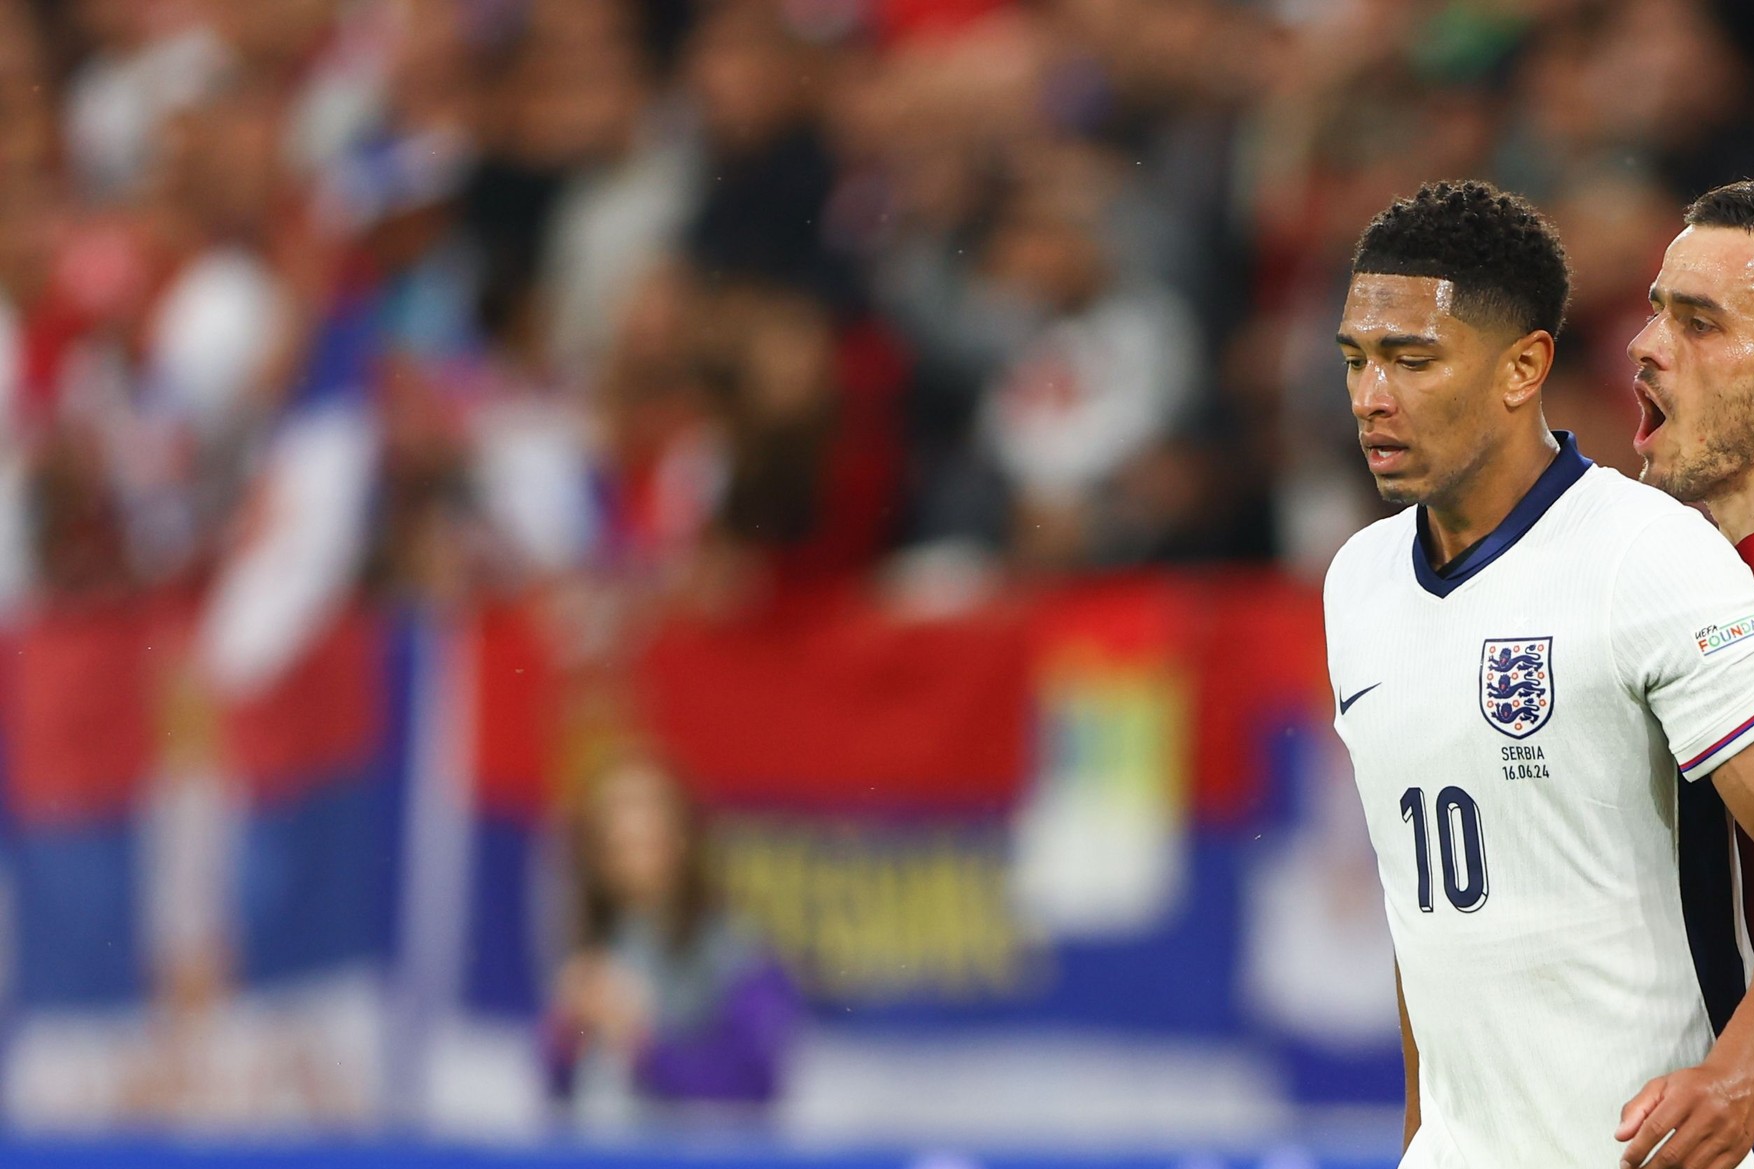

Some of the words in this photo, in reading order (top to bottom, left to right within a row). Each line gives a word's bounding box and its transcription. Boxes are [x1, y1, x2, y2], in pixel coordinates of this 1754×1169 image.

[1695, 624, 1718, 640] UEFA
[1501, 746, 1545, 761] SERBIA
[1502, 764, 1549, 780] 16.06.24
[1400, 786, 1489, 913] 10
